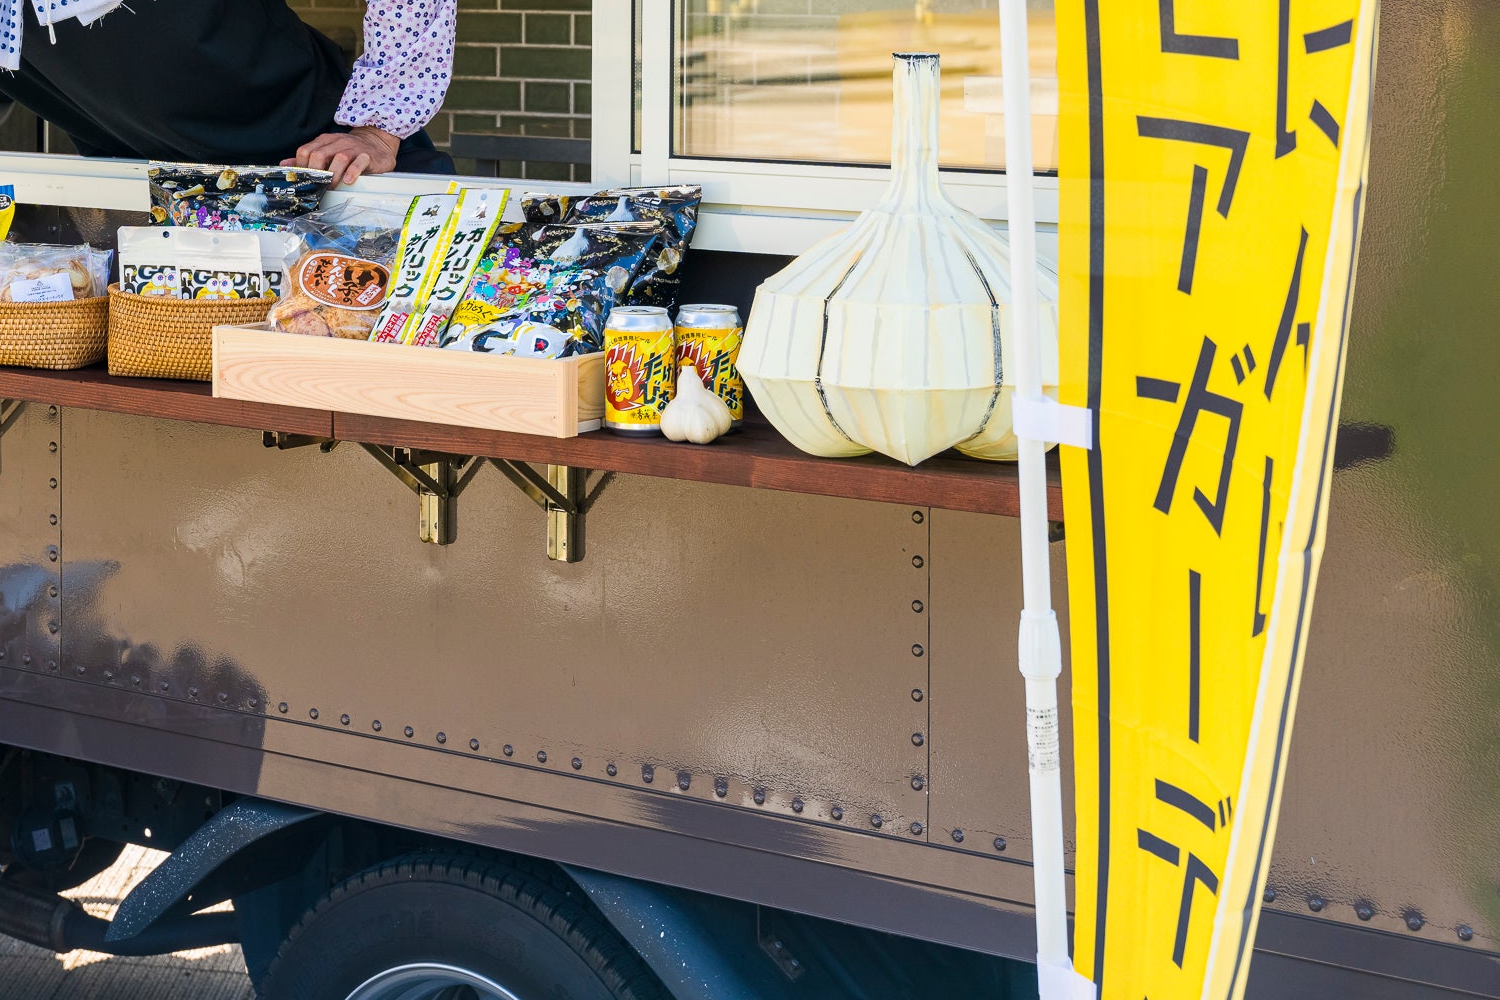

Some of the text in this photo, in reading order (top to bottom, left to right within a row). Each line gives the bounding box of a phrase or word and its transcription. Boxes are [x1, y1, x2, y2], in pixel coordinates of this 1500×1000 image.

[326, 257, 347, 298] にんにく
[392, 224, 441, 298] ガーリック
[436, 227, 487, 301] ガーリック
